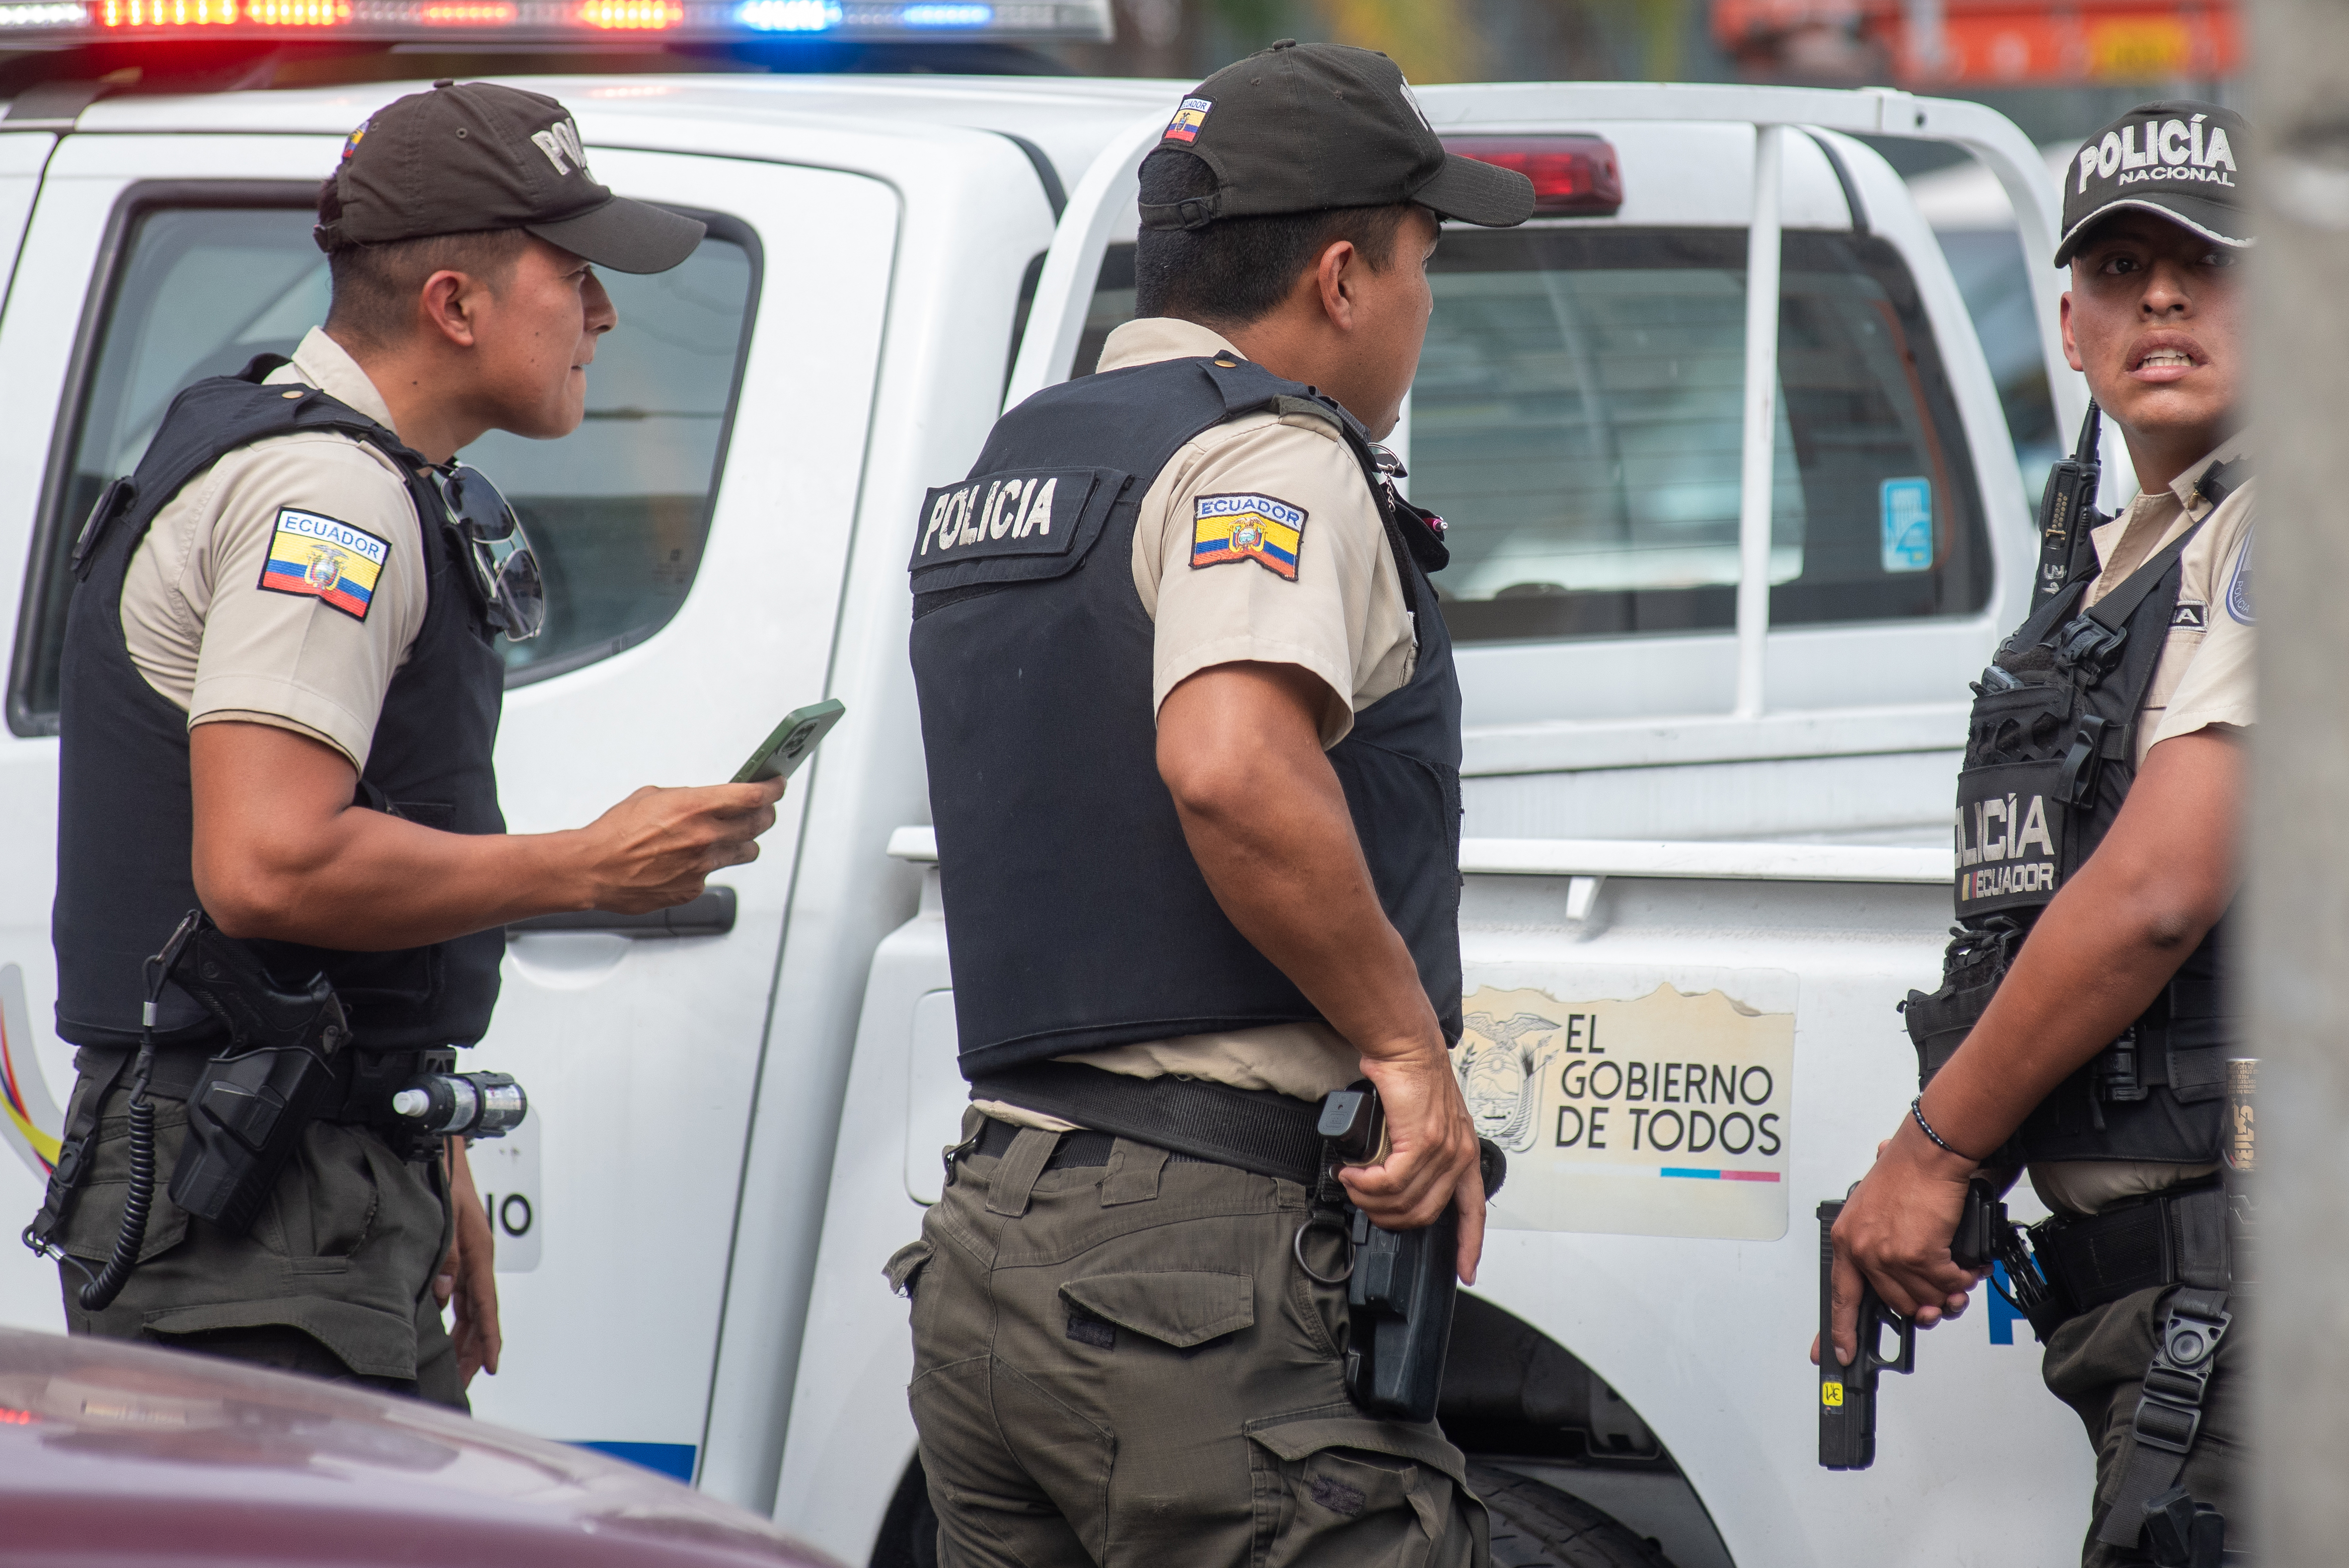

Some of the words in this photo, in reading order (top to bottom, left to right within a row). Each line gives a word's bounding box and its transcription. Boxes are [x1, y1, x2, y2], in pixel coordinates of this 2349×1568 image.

[2078, 113, 2237, 195] POLICÍA
[2119, 166, 2235, 187] NACIONAL
[920, 477, 1058, 556] POLICIA
[1201, 498, 1300, 527] ECUADOR
[284, 515, 380, 559] ECUADOR
[2234, 580, 2250, 613] POLICIA
[1976, 862, 2054, 899] ECUADOR
[1566, 1013, 1605, 1055] EL
[1561, 1060, 1773, 1106] GOBIERNO
[1555, 1105, 1609, 1149] DE
[1628, 1107, 1781, 1156] TODOS
